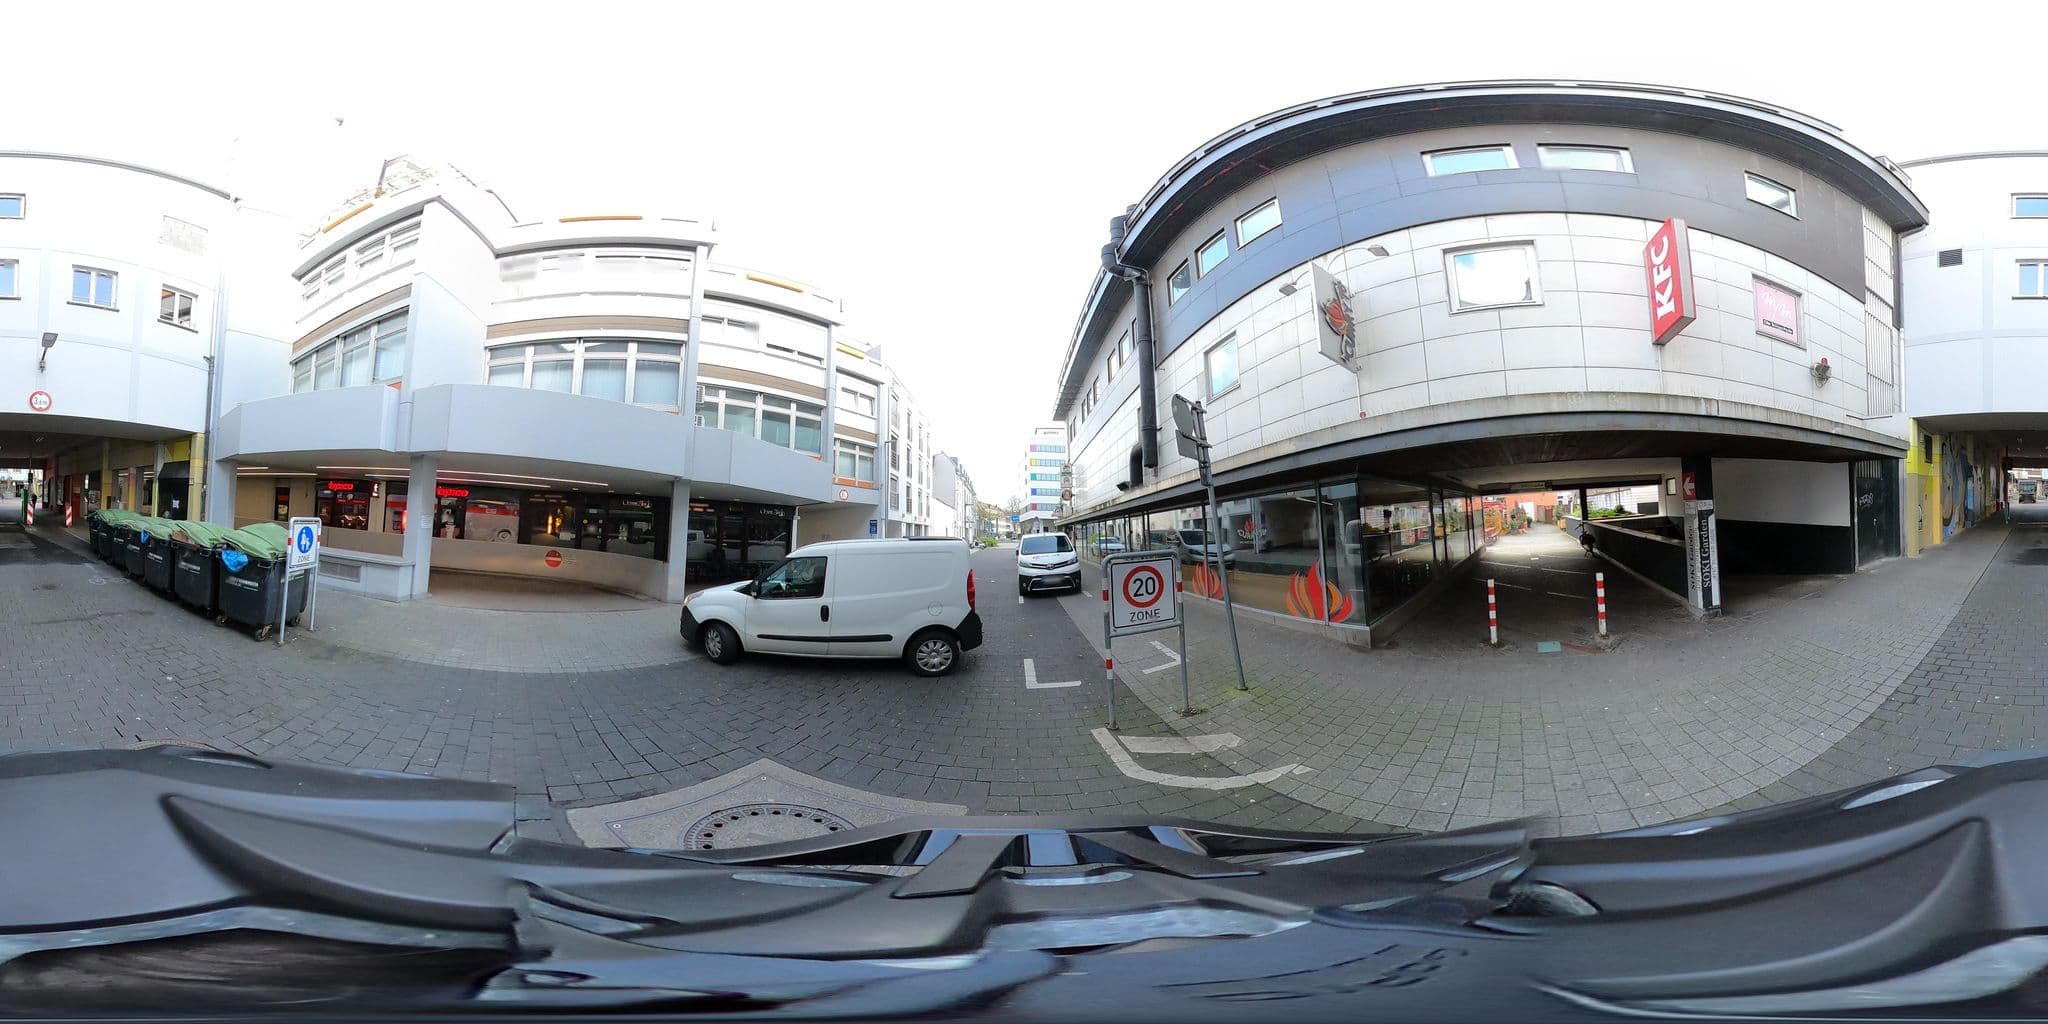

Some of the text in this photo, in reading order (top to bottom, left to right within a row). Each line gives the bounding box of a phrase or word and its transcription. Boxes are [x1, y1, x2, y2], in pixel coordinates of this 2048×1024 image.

[1651, 235, 1675, 320] KFC
[1701, 520, 1710, 557] Garden
[1133, 576, 1155, 597] 20
[1702, 560, 1711, 588] SOKI
[1129, 608, 1160, 622] ZONE
